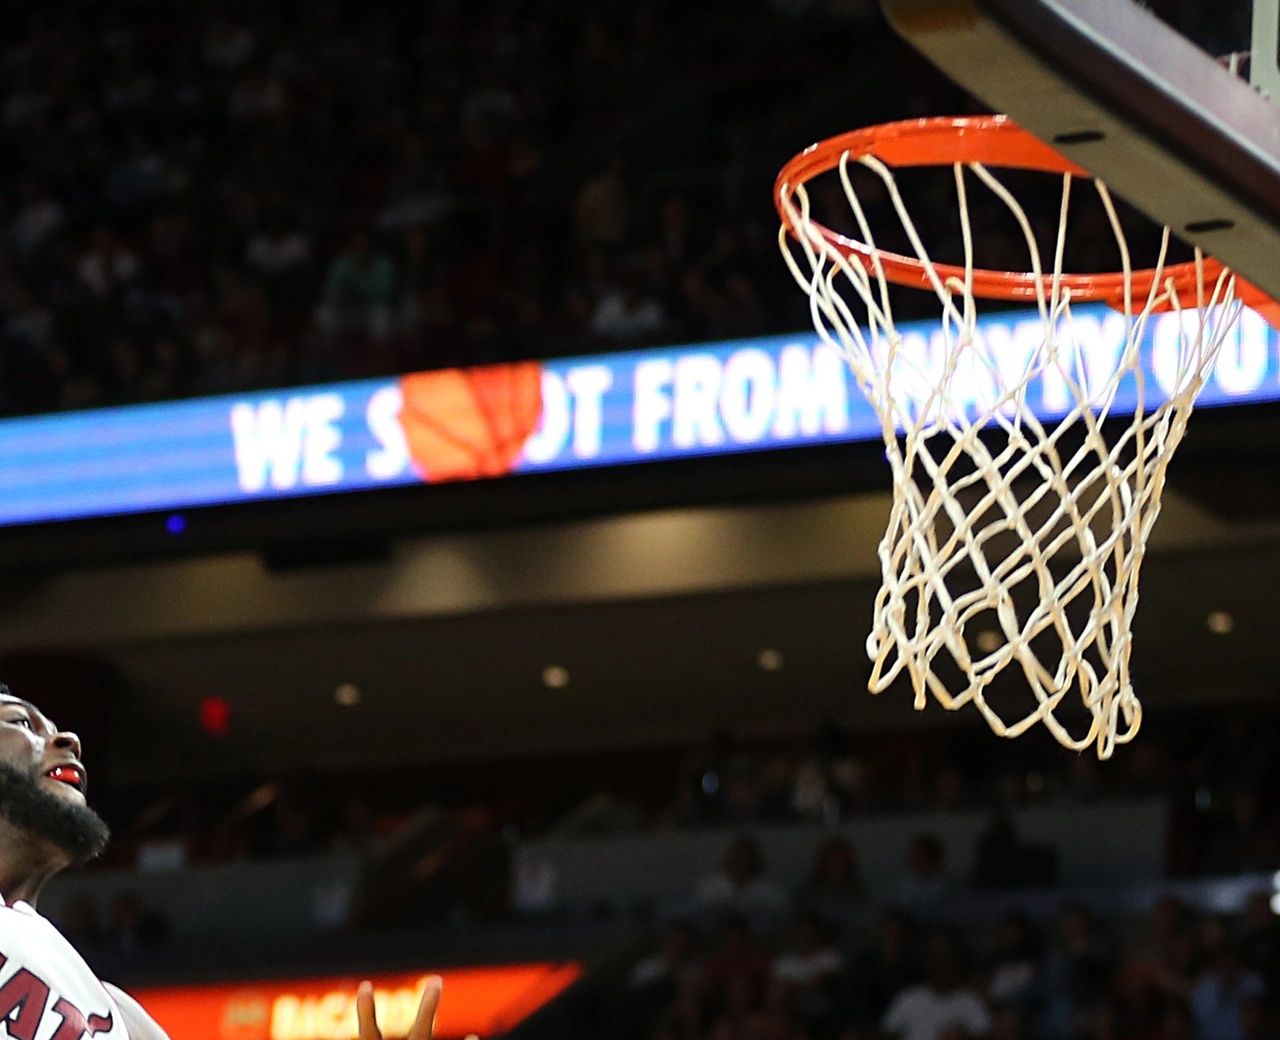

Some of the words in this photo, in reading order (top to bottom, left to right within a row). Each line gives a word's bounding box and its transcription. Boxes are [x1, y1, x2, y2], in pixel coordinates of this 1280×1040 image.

[228, 392, 345, 494] WE
[365, 364, 613, 480] SOT
[630, 341, 849, 454] FROM
[1152, 303, 1280, 400] OU
